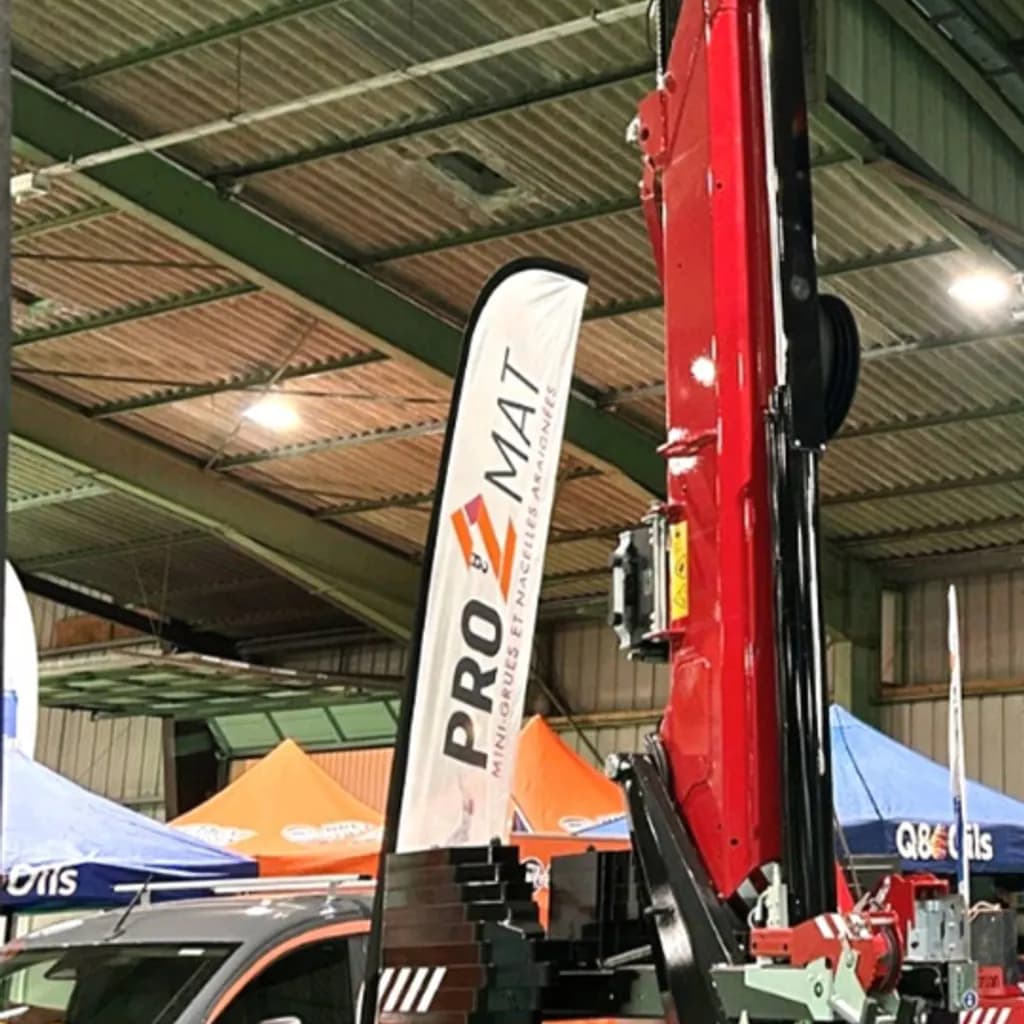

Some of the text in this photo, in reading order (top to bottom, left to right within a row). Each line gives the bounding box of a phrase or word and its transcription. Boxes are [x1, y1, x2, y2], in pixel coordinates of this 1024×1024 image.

[444, 599, 502, 768] PRO
[485, 348, 539, 502] MAT
[510, 615, 524, 638] ET
[896, 822, 933, 861] Q8
